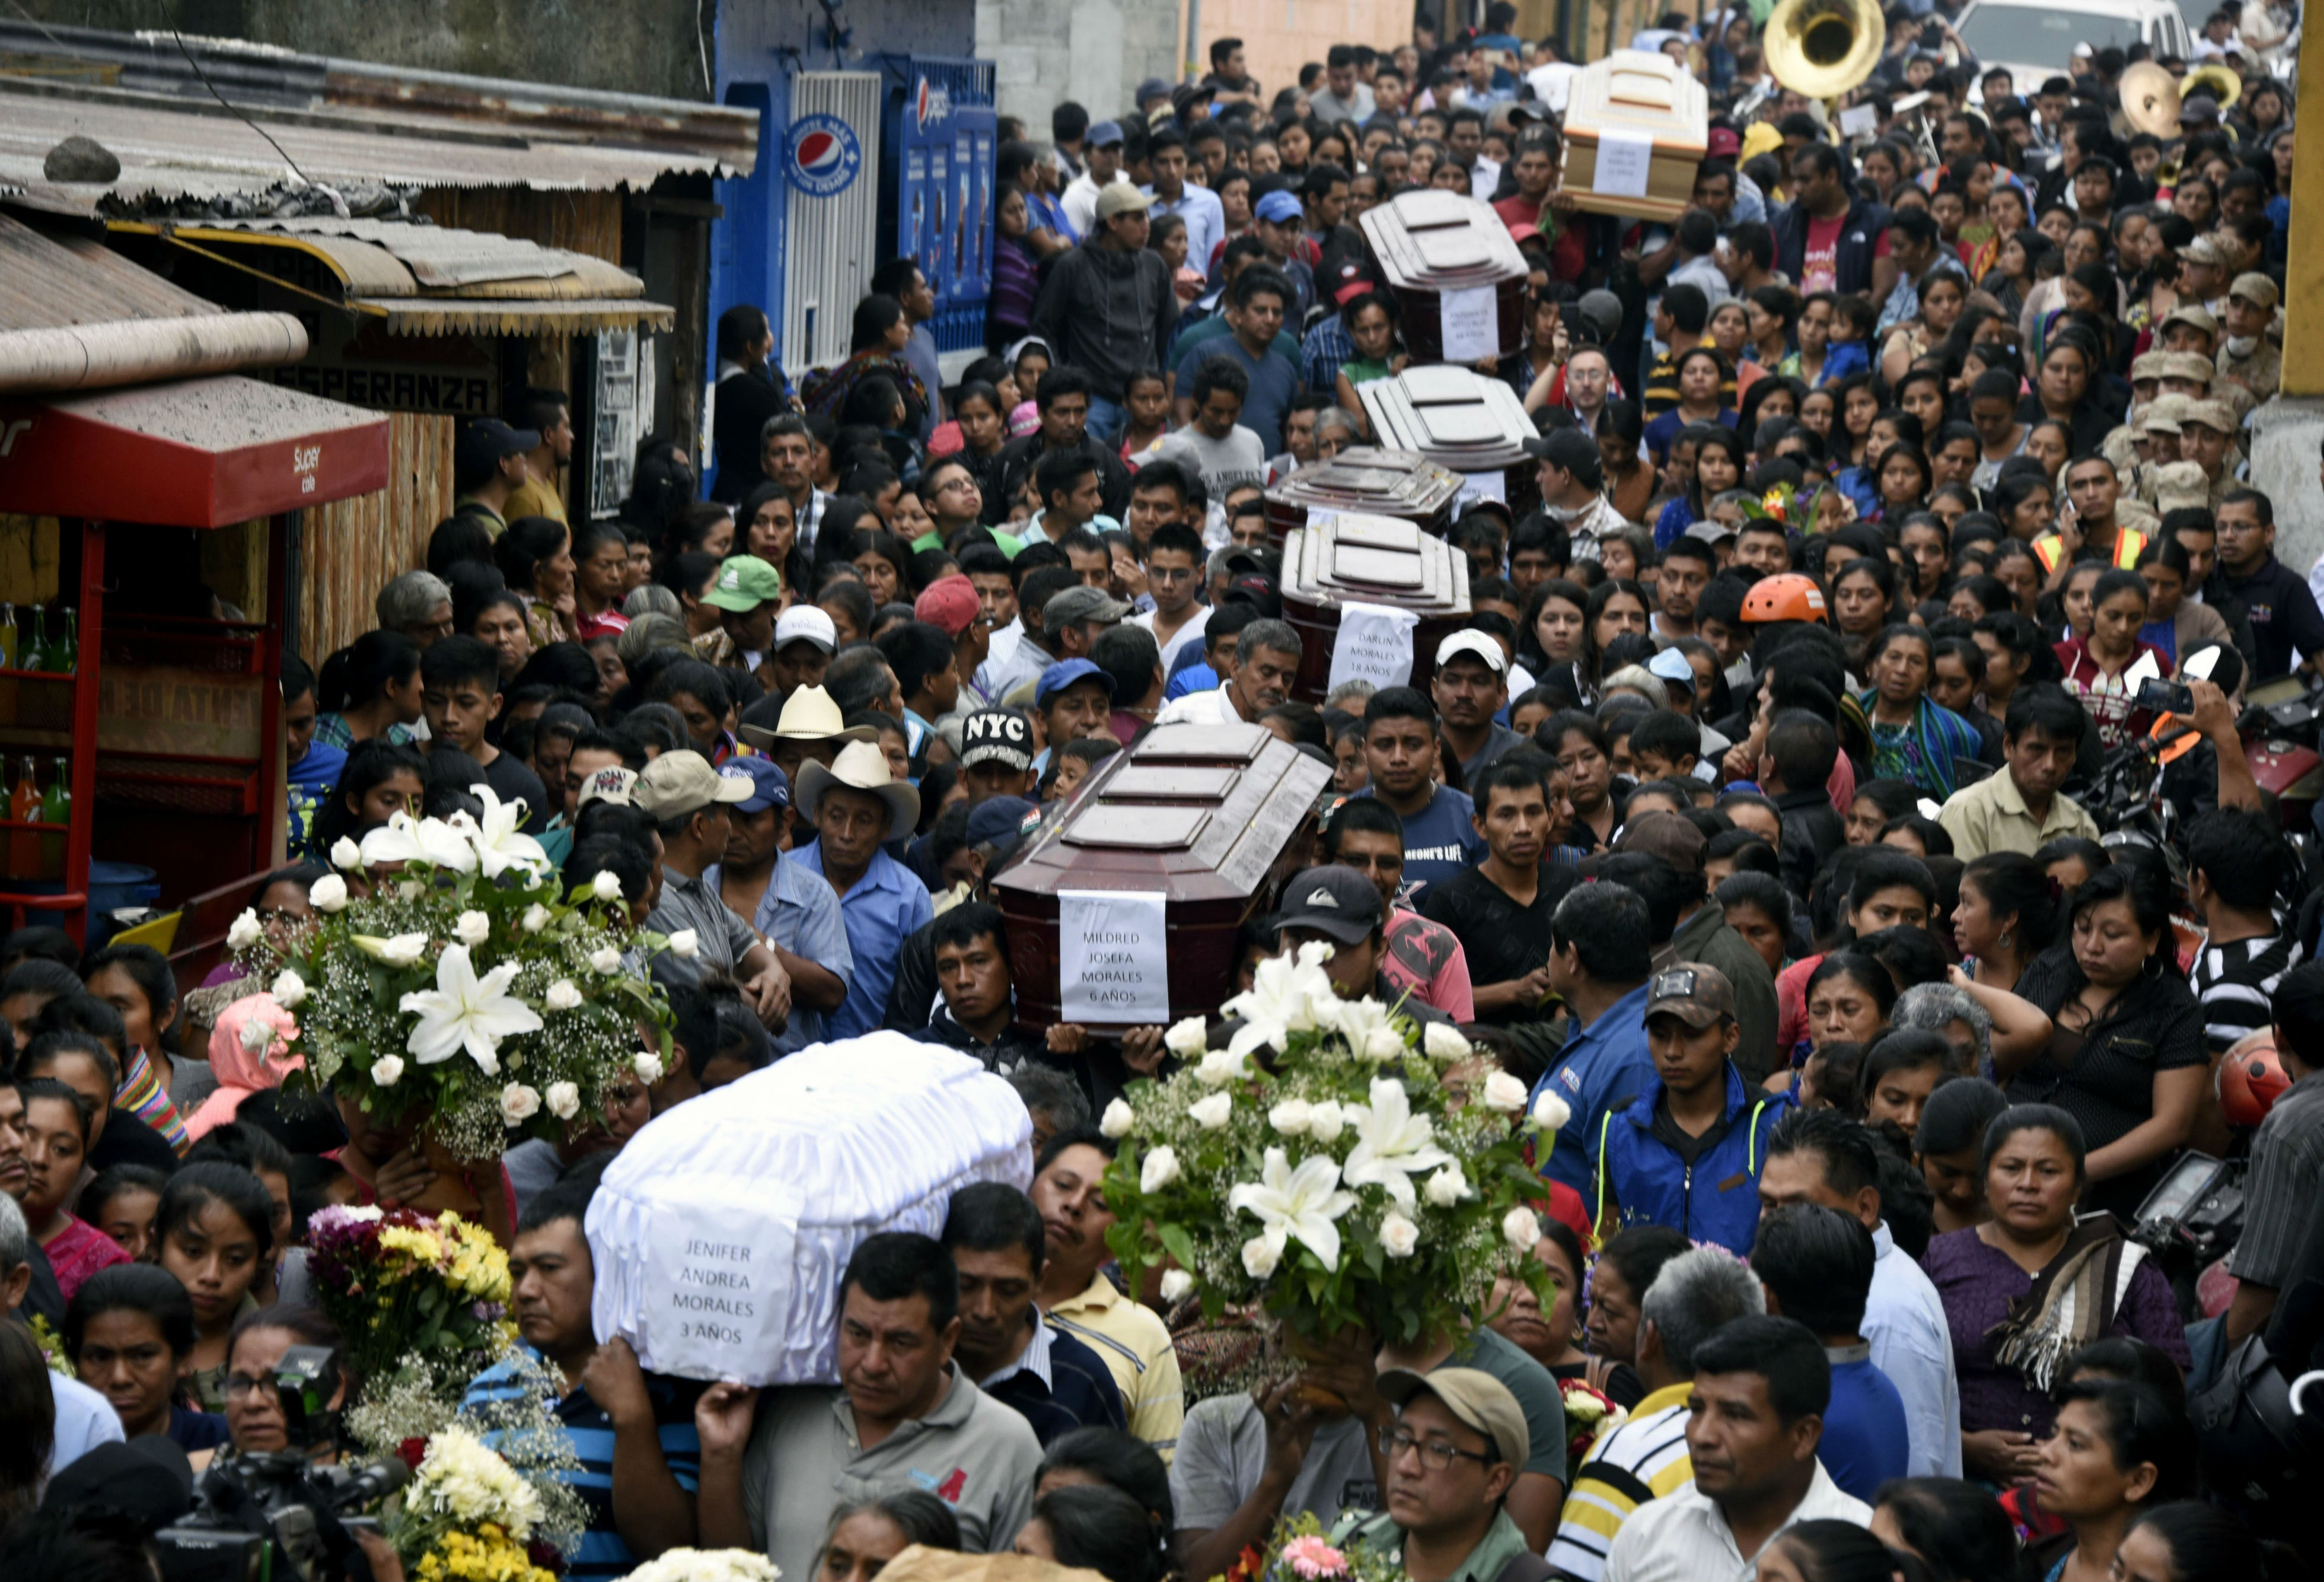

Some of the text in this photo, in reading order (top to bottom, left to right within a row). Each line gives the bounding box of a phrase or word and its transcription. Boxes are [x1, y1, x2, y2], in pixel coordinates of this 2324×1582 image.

[294, 445, 321, 474] Super
[1359, 633, 1393, 647] DARLIN
[1351, 646, 1395, 661] MORALES
[1351, 662, 1391, 677] 18 AÑOS
[966, 713, 1023, 742] NYC
[1445, 843, 1462, 862] LIFE
[1083, 931, 1140, 945] MILDRED
[1088, 951, 1134, 965] JOSEFA
[1082, 971, 1143, 983] MORALES
[1090, 988, 1137, 1003] 6 AÑOS
[685, 1240, 751, 1263] JENIFER
[680, 1267, 750, 1290] ANDREA
[672, 1293, 754, 1317] MORALES
[681, 1321, 742, 1345] 3 AÑOS
